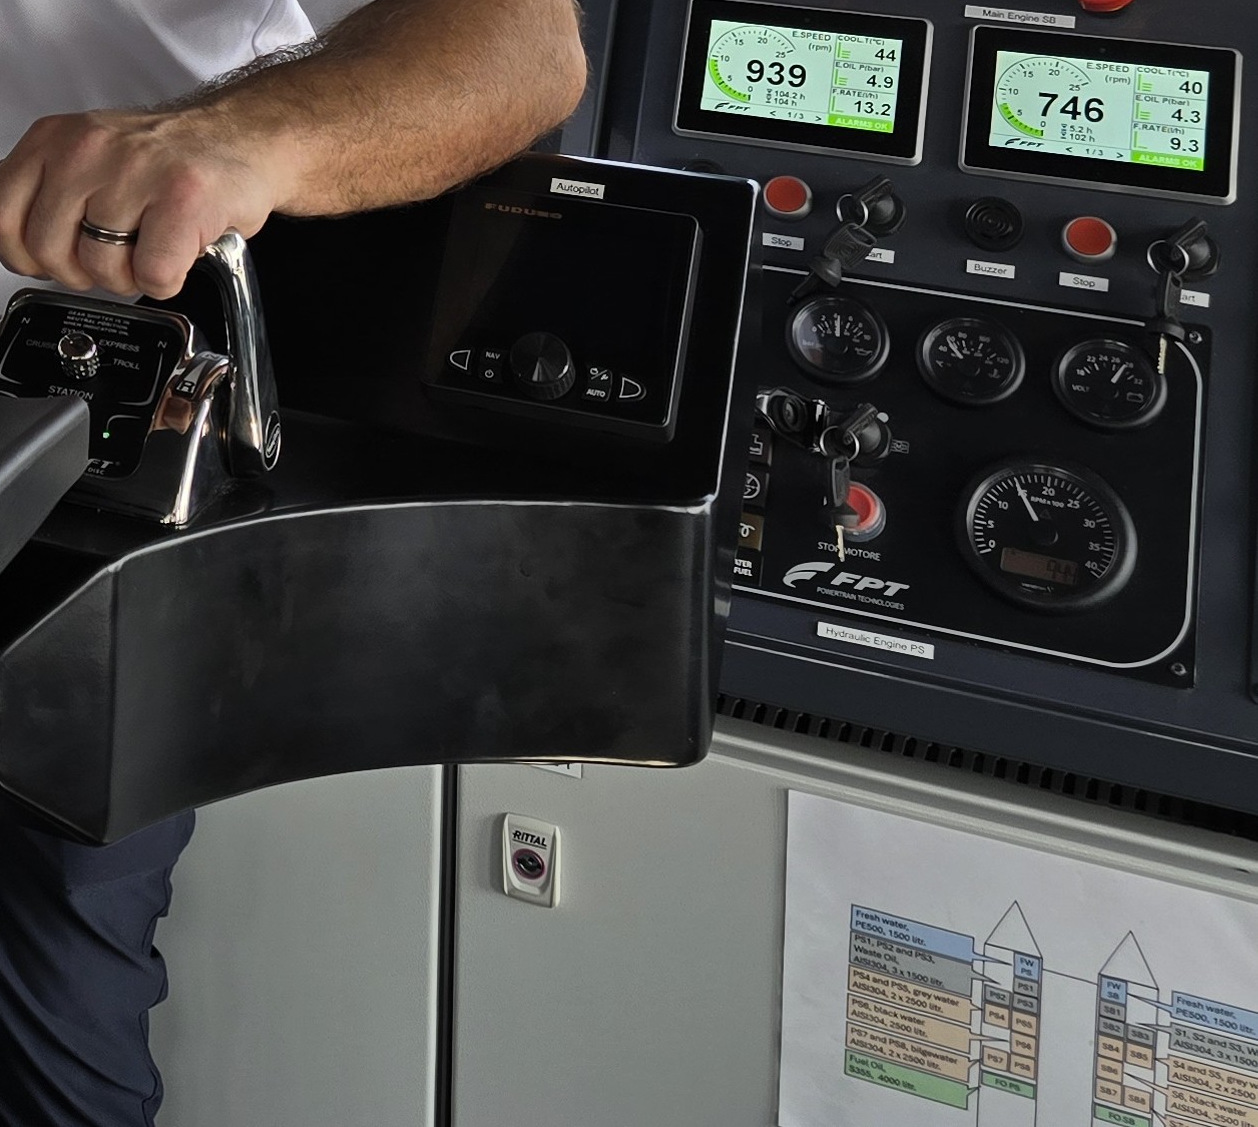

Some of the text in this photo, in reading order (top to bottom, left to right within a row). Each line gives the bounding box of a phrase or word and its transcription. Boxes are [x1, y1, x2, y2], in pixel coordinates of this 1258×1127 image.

[982, 10, 1056, 24] Main Engine SB
[734, 38, 744, 46] 15
[792, 30, 832, 42] E.SPEED
[808, 43, 832, 52] (rpm)
[874, 48, 896, 62] 44
[746, 59, 806, 87] 939
[1086, 63, 1130, 73] E.SPEED
[866, 75, 894, 88] 4.9
[1105, 76, 1131, 85] (rpm)
[774, 90, 797, 98] 104.2
[1008, 88, 1018, 96] 10
[1180, 81, 1202, 94] 40
[854, 101, 892, 116] 13.2
[1038, 91, 1104, 123] 746
[1172, 108, 1200, 123] 4.3
[836, 118, 888, 130] ALARMS OK
[1170, 137, 1199, 152] 9.3
[1139, 154, 1196, 168] ALARMS OK
[556, 183, 599, 196] Autopilot
[771, 237, 792, 246] Stop
[974, 264, 1007, 274] Buzzer
[1073, 277, 1096, 288] Stop
[99, 339, 140, 352] EXPRESS
[486, 352, 500, 360] NAV
[113, 358, 140, 370] TROLL
[48, 385, 94, 400] STATION
[586, 388, 606, 398] AUTO
[1042, 488, 1055, 496] 20
[998, 502, 1008, 510] 10
[1067, 499, 1080, 509] 25
[988, 520, 994, 528] 5
[1084, 519, 1095, 528] 30
[988, 540, 996, 548] 0
[1088, 542, 1100, 551] 35
[1085, 561, 1098, 569] 40
[830, 572, 910, 596] FPT
[817, 586, 904, 610] POWERTRAIN TECHNOLOGIES
[826, 626, 924, 654] Hydraulic Engine PS
[512, 830, 546, 847] RITTAL
[856, 910, 910, 931] Fresh water,
[856, 921, 926, 946] PE500, 1500 litr.
[854, 934, 936, 964] PS1, PS2 and PS3,
[854, 945, 899, 964] Waste Oil,
[853, 970, 959, 1006] PS4 and PS5, grey water
[1018, 982, 1033, 992] PS1
[990, 990, 1006, 1000] PS2
[1017, 998, 1034, 1008] PS3
[1177, 997, 1236, 1019] Fresh water,
[852, 999, 925, 1025] PS6, black water
[989, 1011, 1004, 1021] PS4
[1176, 1008, 1256, 1035] PE500, 1500 litr.
[851, 1027, 958, 1065] PS7 and PS8, bilgewater
[850, 1055, 886, 1072] Fuel Oil,
[988, 1054, 1003, 1064] PS7
[1172, 1090, 1246, 1116] S6, black water
